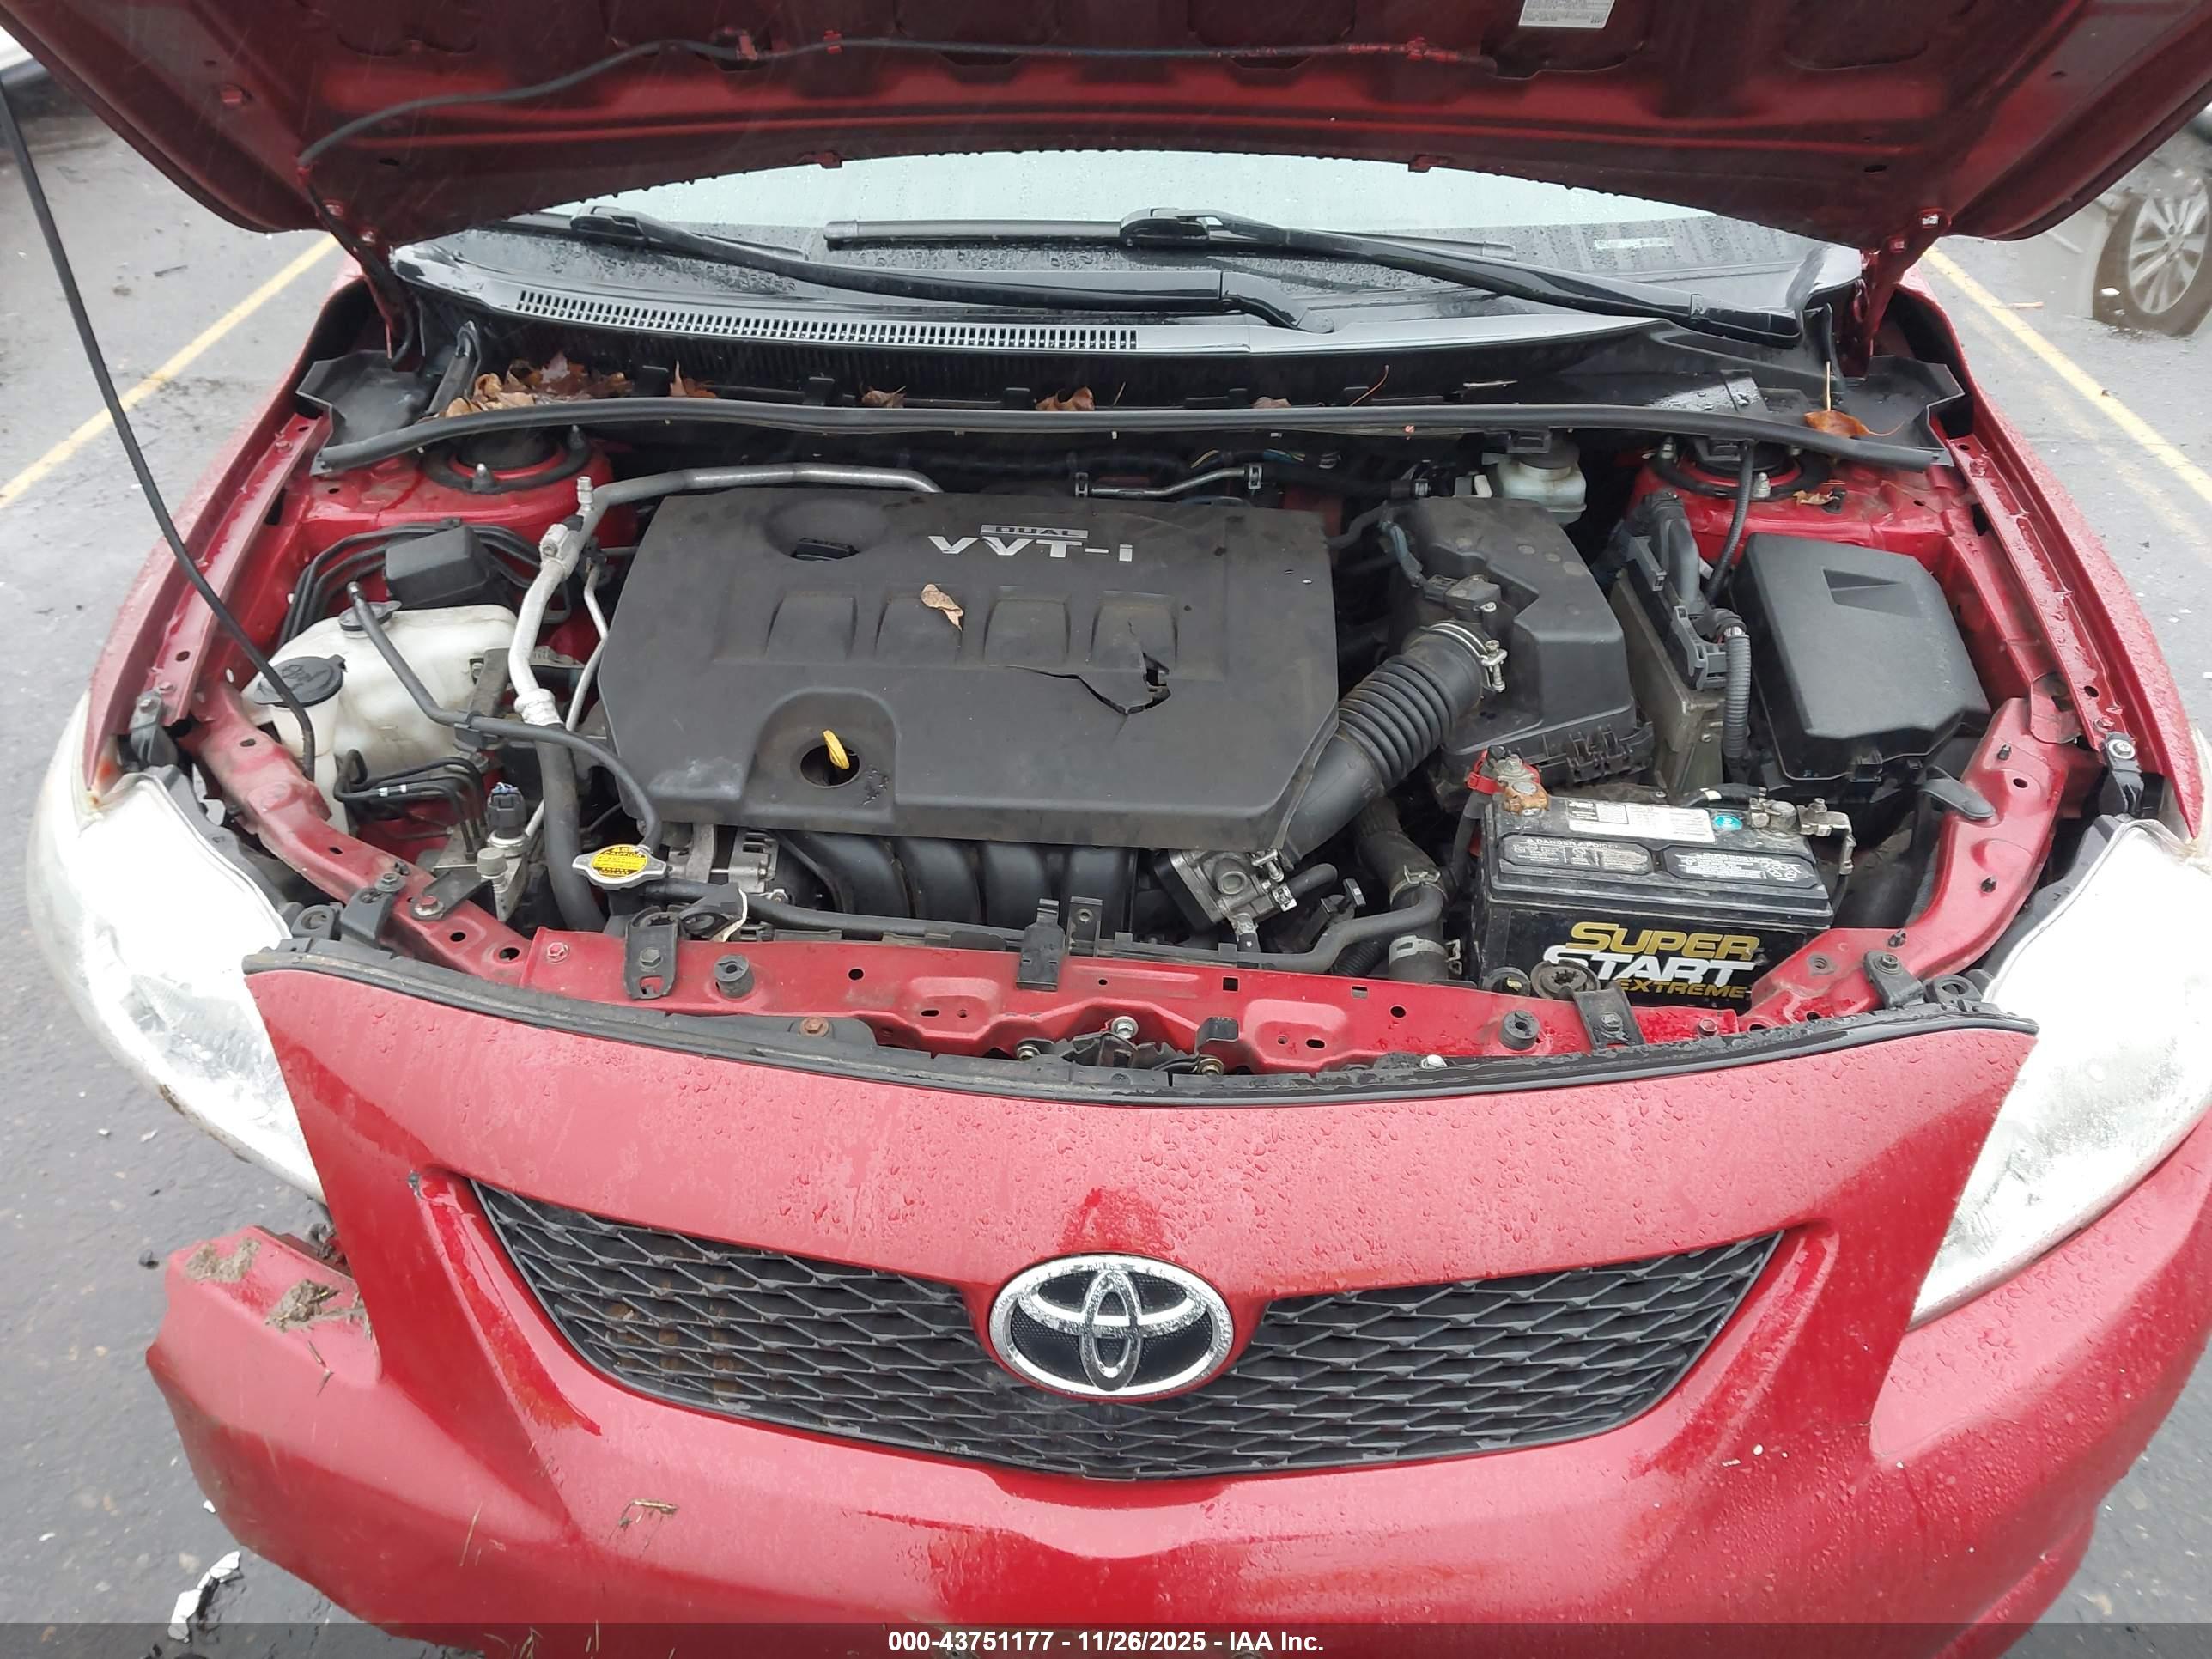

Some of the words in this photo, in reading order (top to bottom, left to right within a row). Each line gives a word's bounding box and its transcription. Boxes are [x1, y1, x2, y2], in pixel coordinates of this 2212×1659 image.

[994, 526, 1080, 537] DUAL
[927, 535, 1133, 562] VVT-i
[1565, 921, 1760, 961] SUPER
[1543, 945, 1755, 988] START
[1620, 979, 1747, 999] EXTREME
